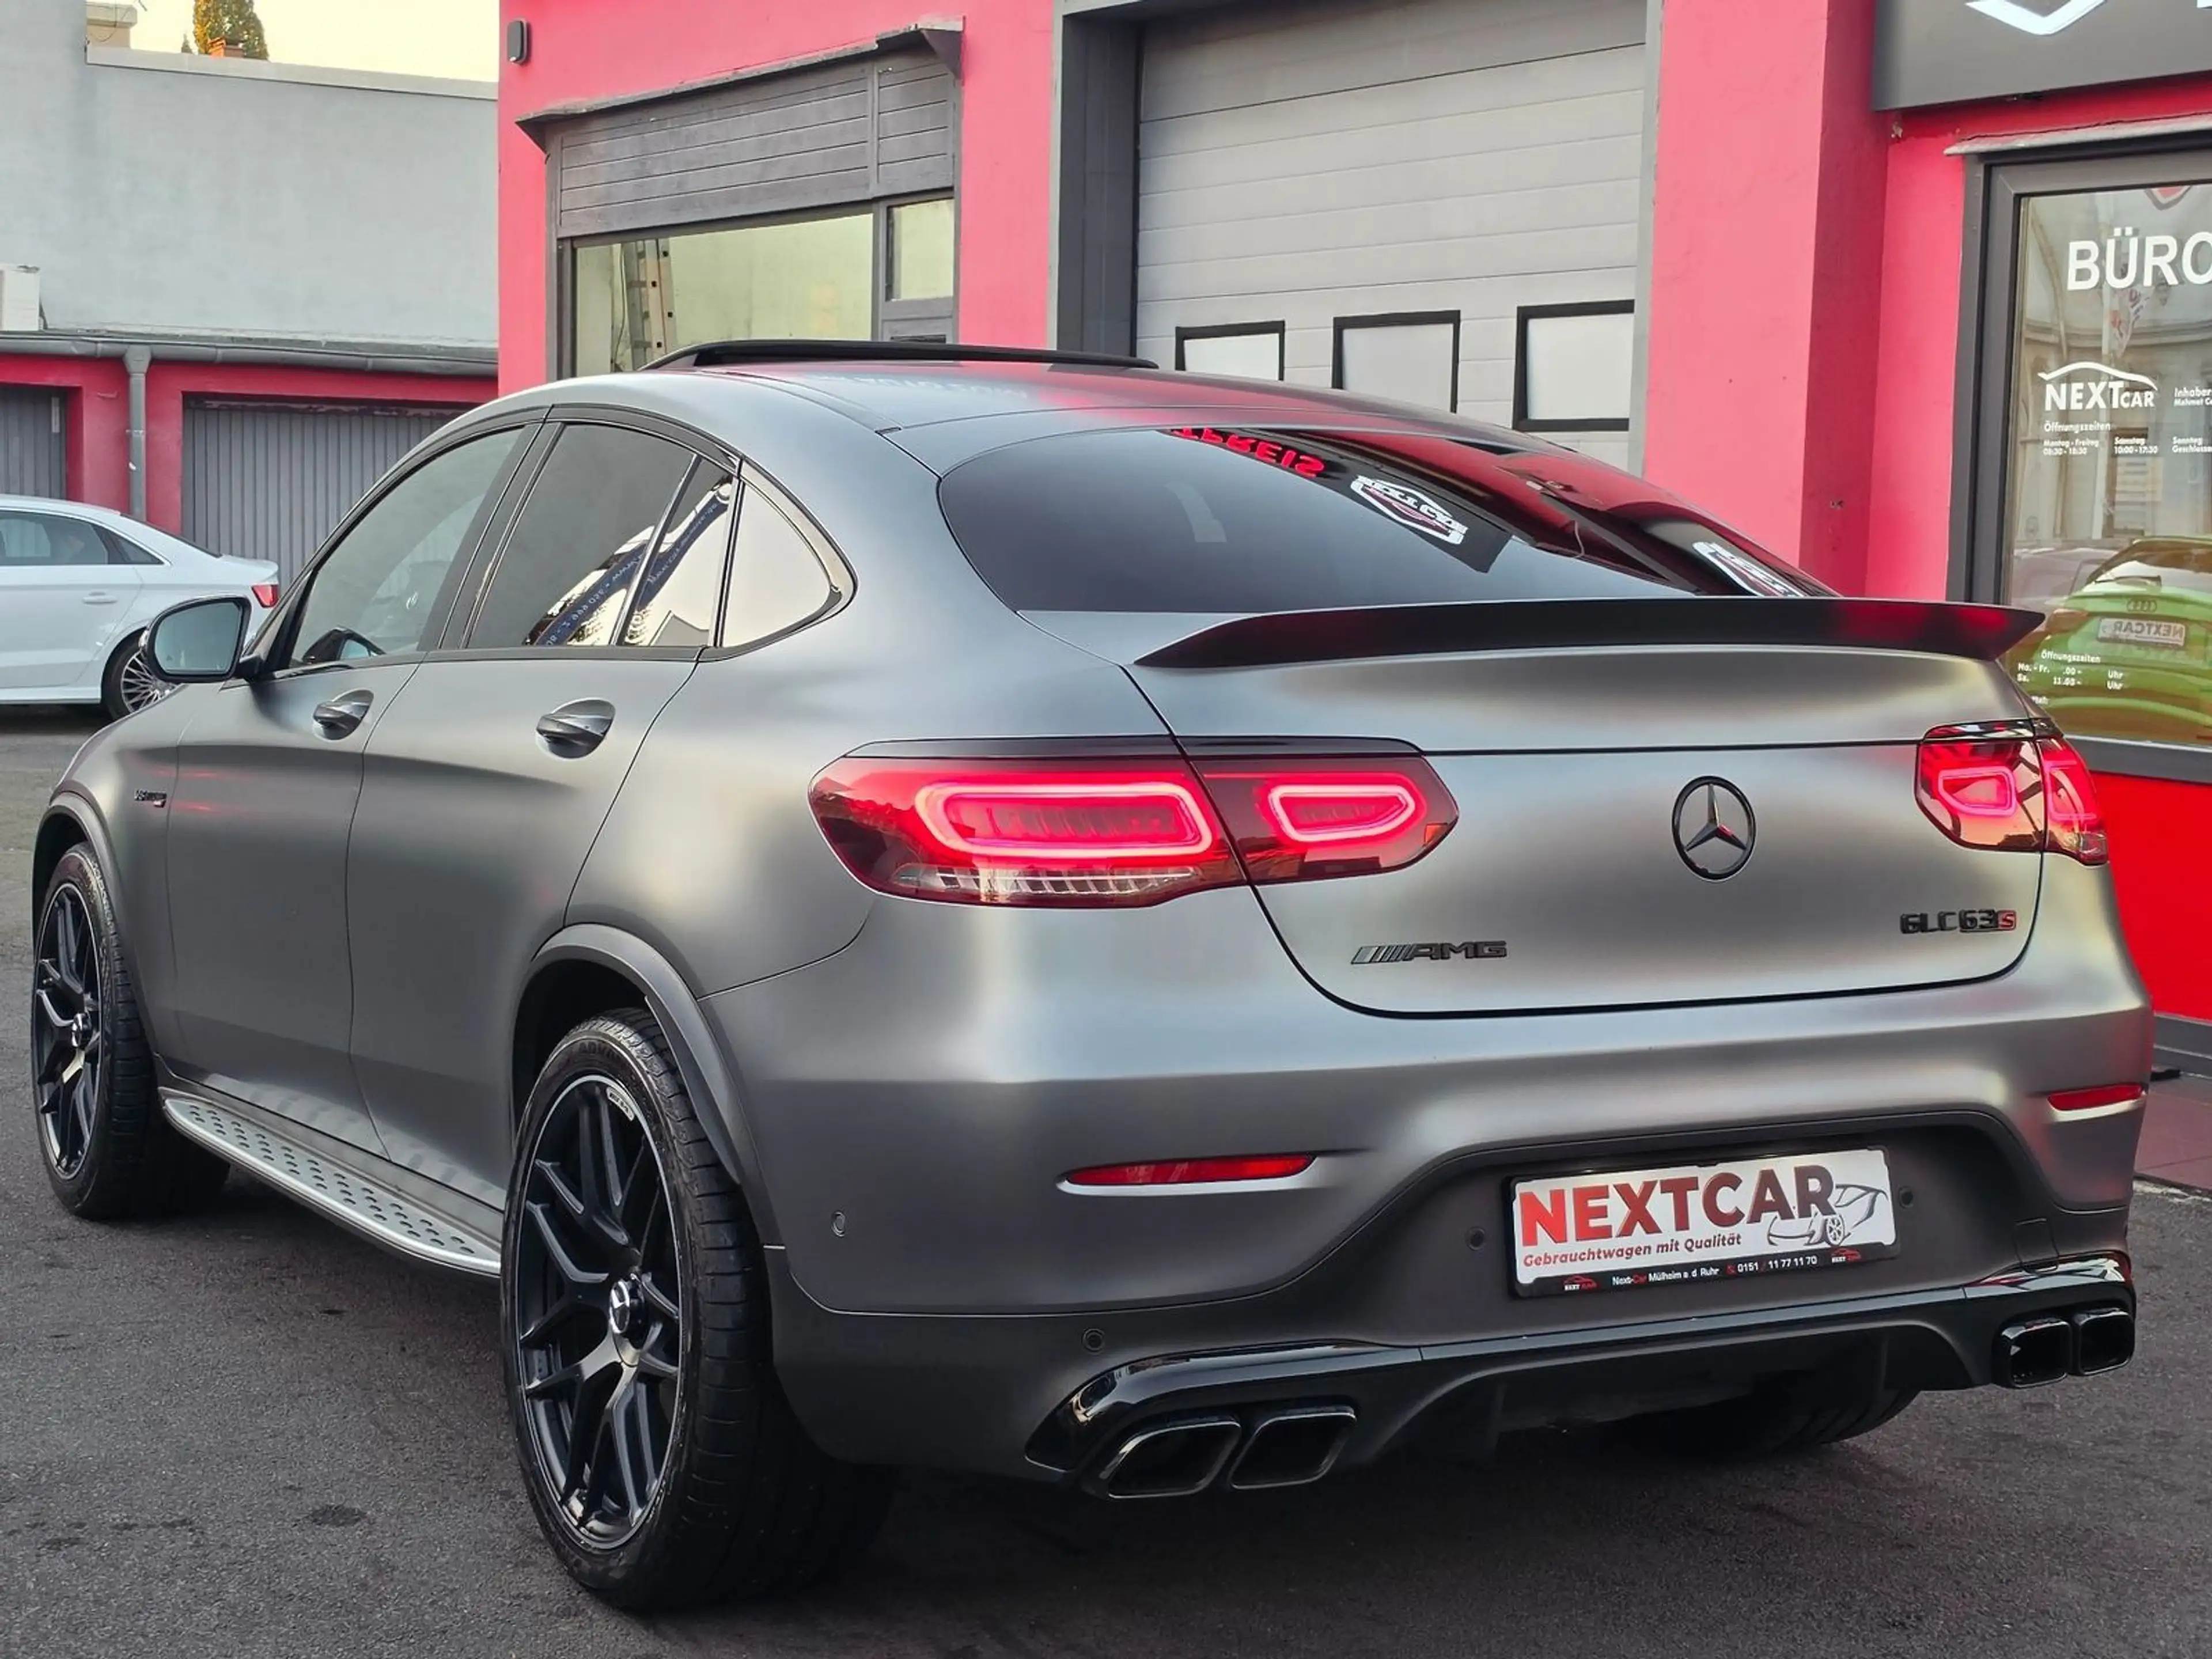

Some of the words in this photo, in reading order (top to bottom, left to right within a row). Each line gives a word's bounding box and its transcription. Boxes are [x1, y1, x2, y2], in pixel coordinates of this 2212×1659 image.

[2067, 226, 2212, 291] BÜRO
[2040, 649, 2101, 664] Öffnungszeiten
[2107, 669, 2124, 679] Uhr
[2106, 680, 2123, 691] Uhr
[1519, 1164, 1836, 1247] NEXTCAR
[1523, 1246, 1652, 1267] Gebrauchtwagen
[1656, 1238, 1679, 1254] mit
[1684, 1232, 1742, 1252] Qualität
[1737, 1262, 1759, 1272] 0151
[1768, 1259, 1779, 1269] 11
[1781, 1258, 1791, 1268] 77
[1793, 1257, 1804, 1267] 11
[1806, 1255, 1818, 1265] 70
[1648, 1271, 1682, 1282] Mülheim
[1700, 1267, 1719, 1277] Ruhr
